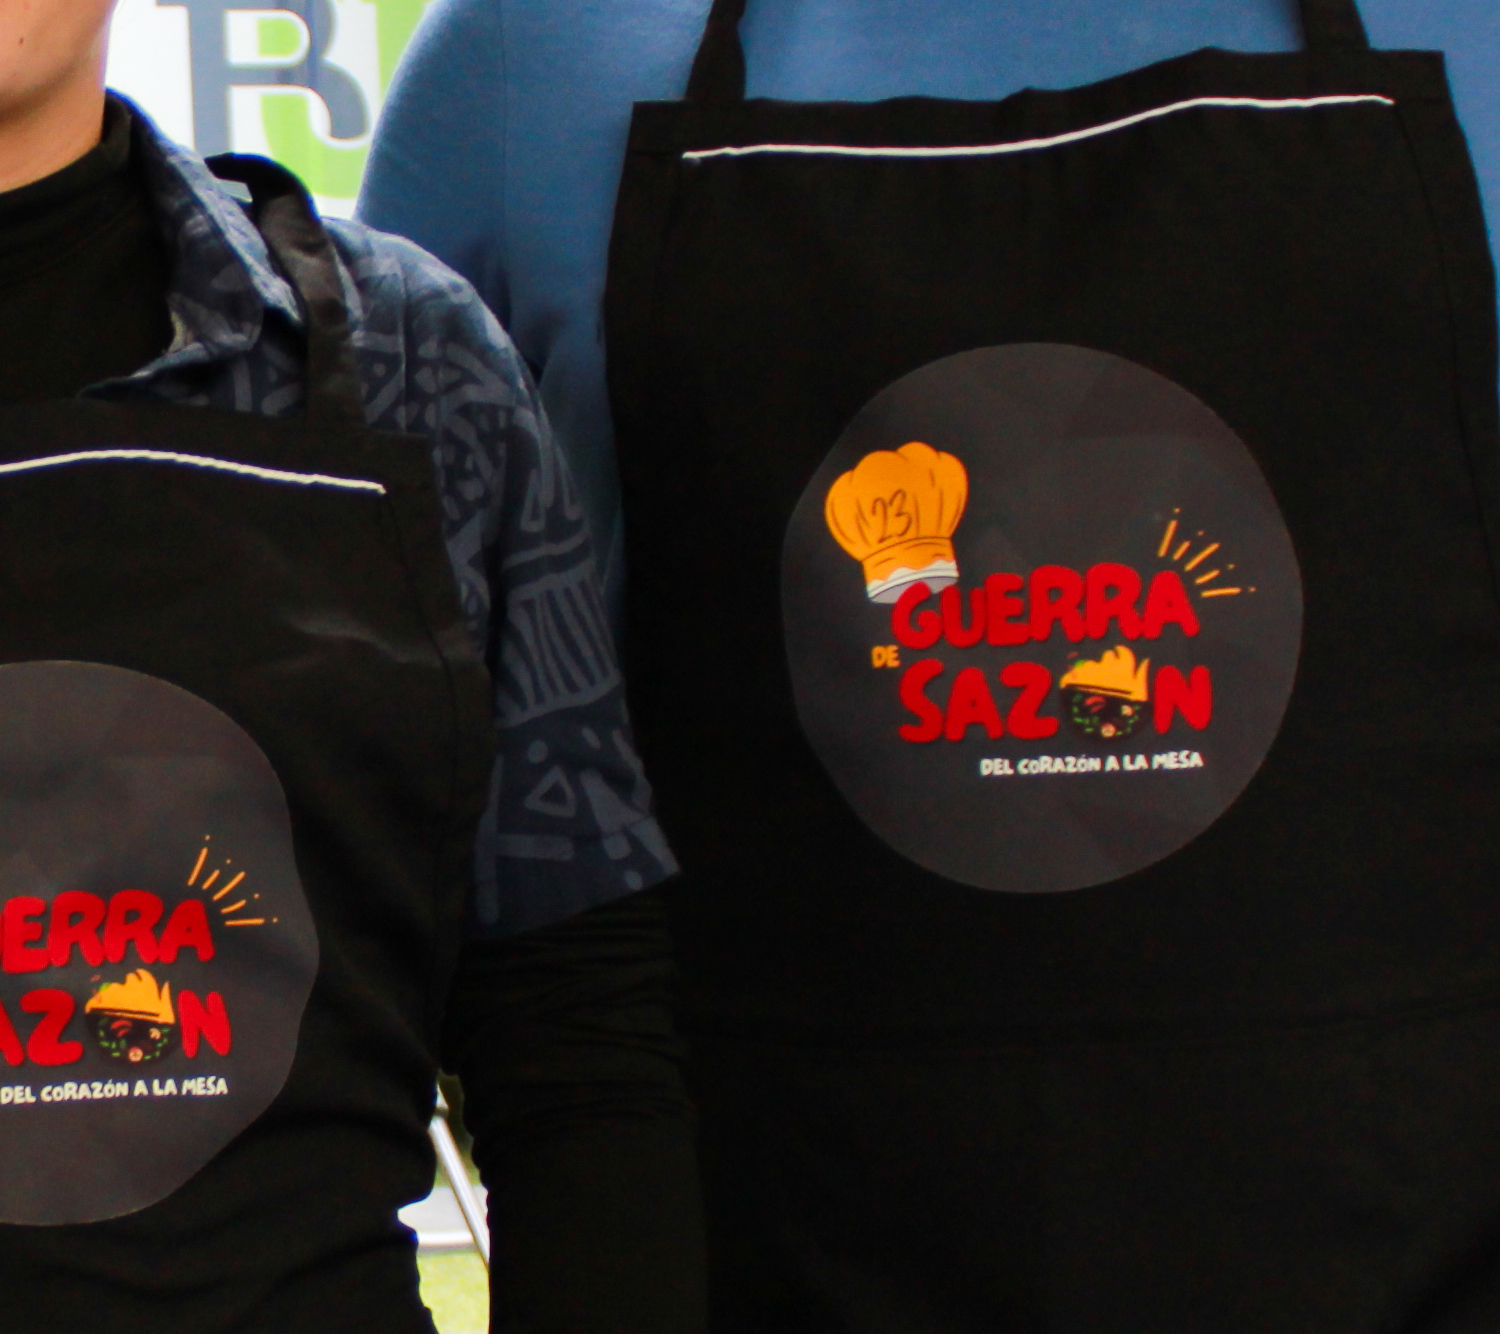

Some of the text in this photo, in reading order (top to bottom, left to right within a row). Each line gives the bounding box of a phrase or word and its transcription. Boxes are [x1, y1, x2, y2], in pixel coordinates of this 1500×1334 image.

[872, 488, 914, 543] 23
[891, 562, 1200, 650] GUERRA
[871, 645, 900, 669] DE
[980, 757, 1014, 777] DEL
[1105, 754, 1121, 772] A
[1122, 753, 1149, 771] LA
[1151, 749, 1204, 770] MESA
[0, 1085, 37, 1105] DEL
[133, 1080, 149, 1098] A
[152, 1078, 179, 1097] LA
[180, 1076, 229, 1097] MESA
